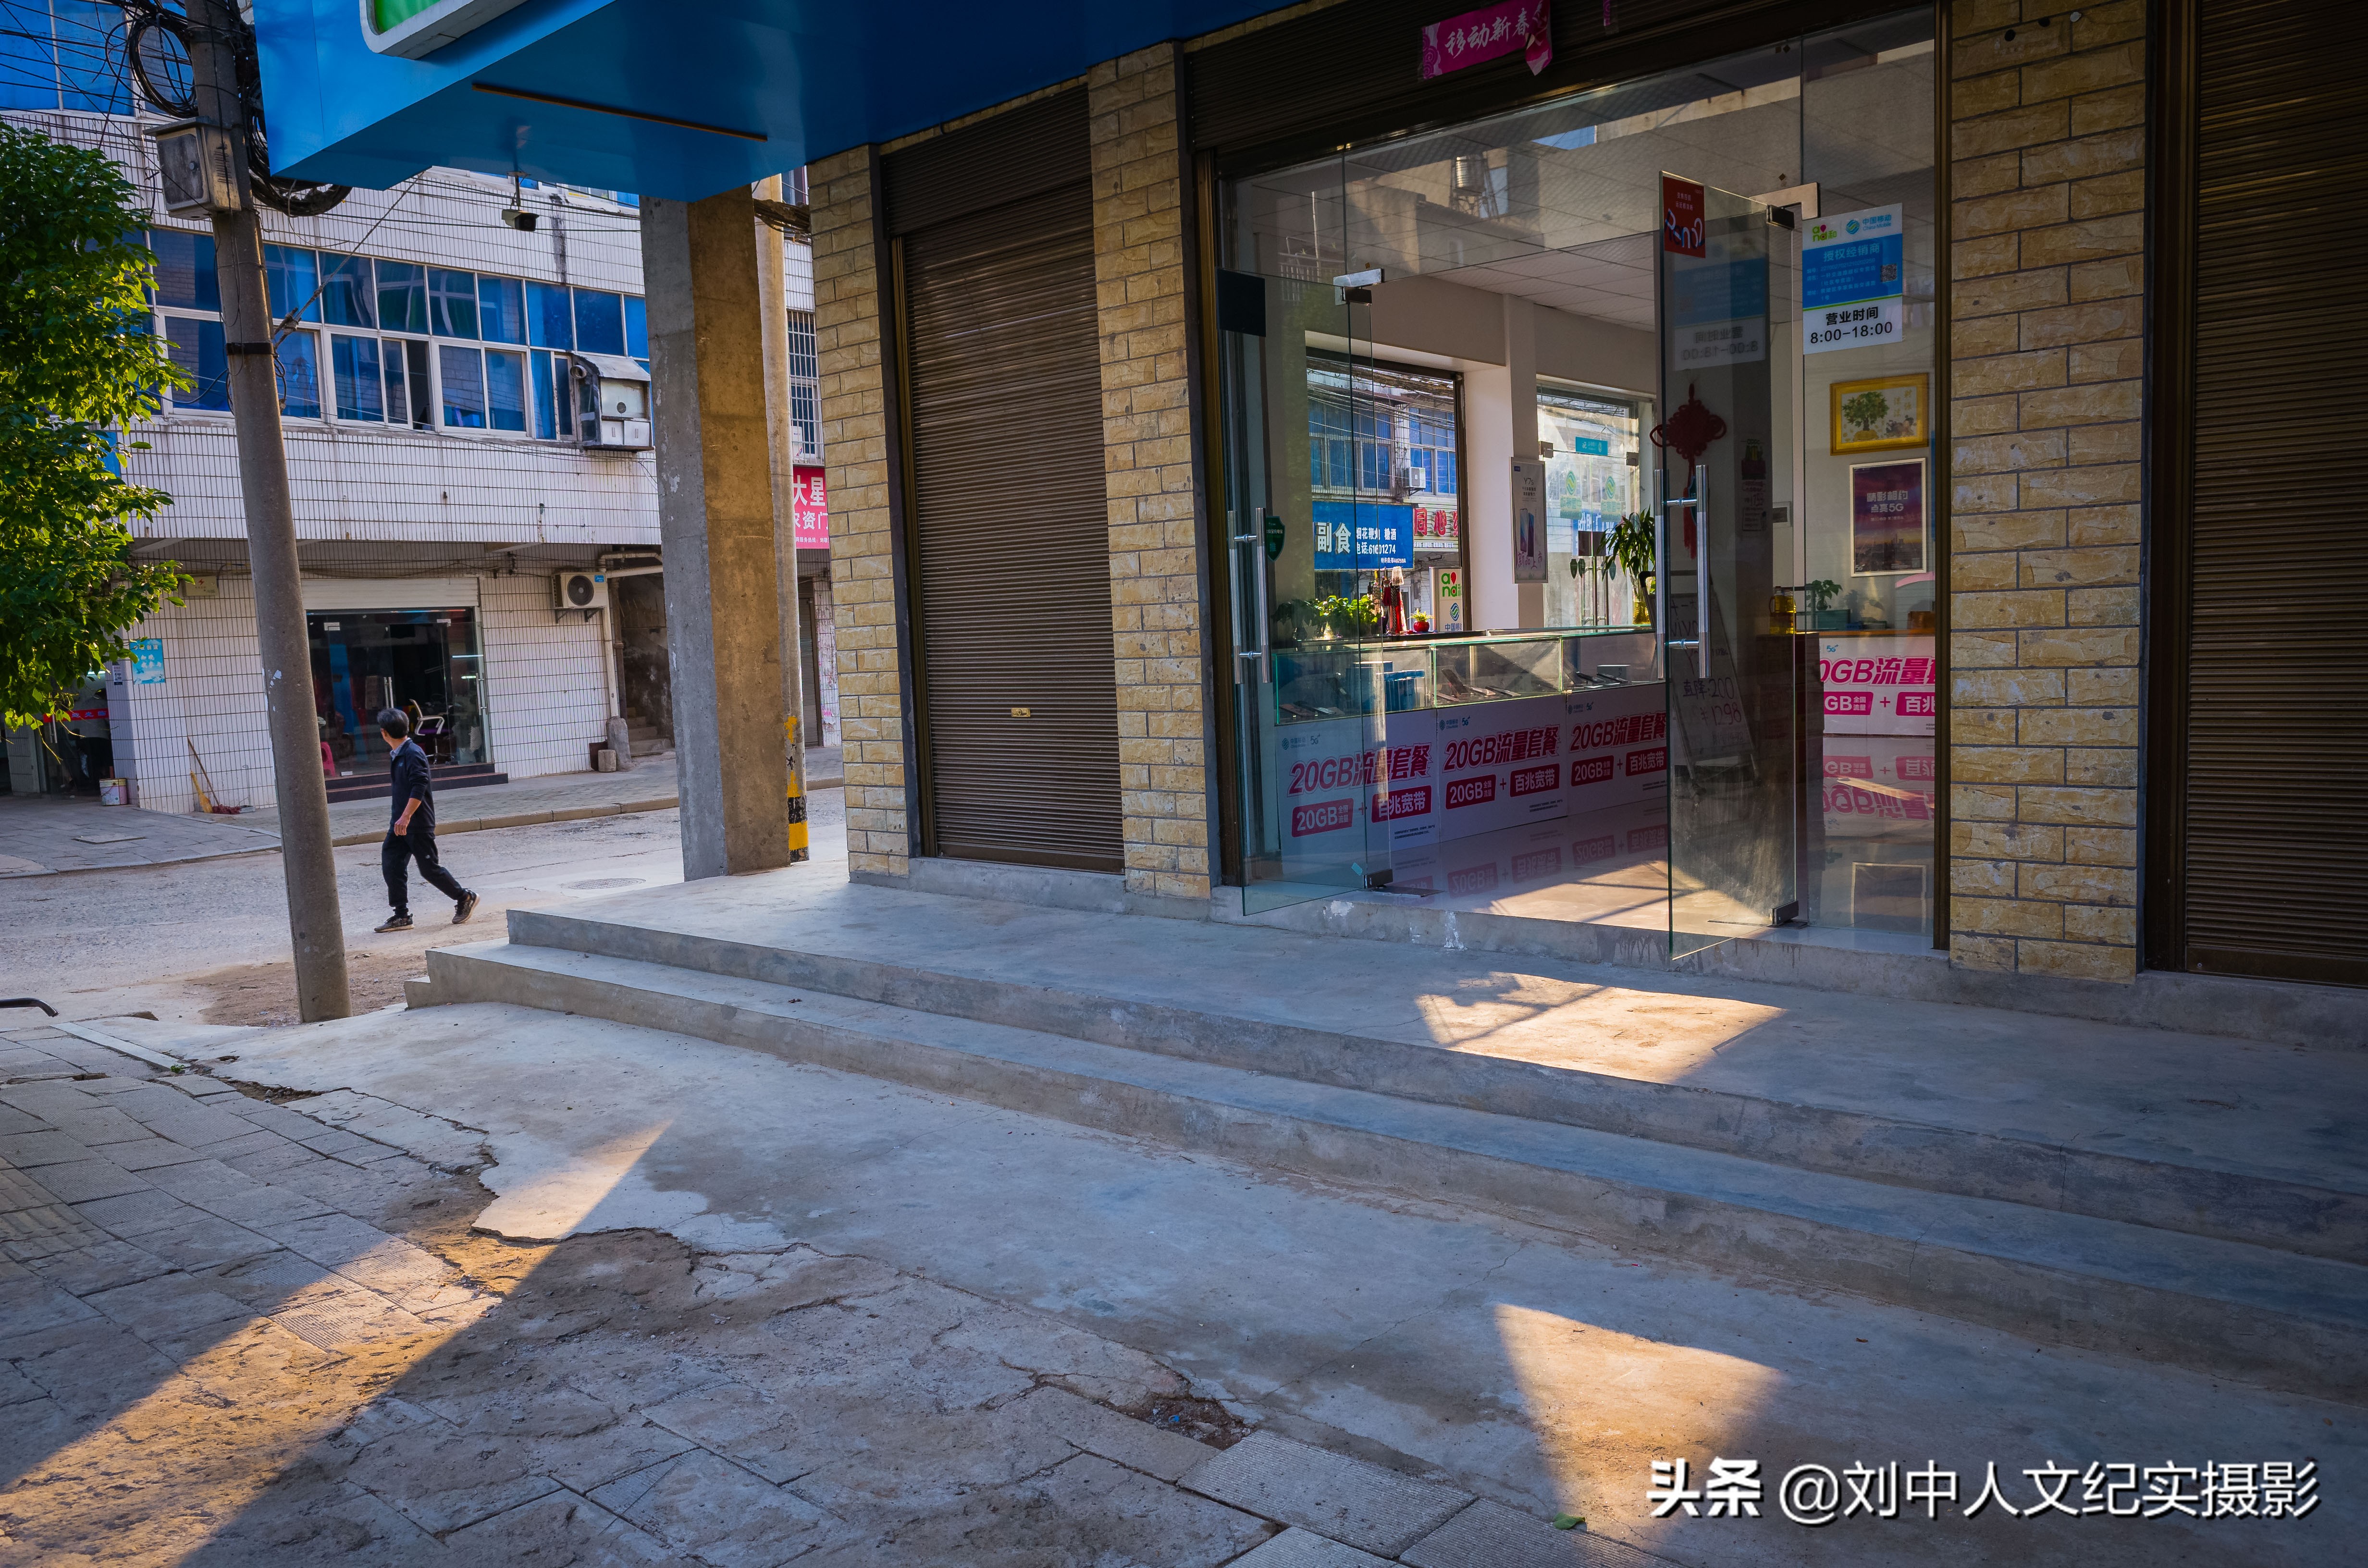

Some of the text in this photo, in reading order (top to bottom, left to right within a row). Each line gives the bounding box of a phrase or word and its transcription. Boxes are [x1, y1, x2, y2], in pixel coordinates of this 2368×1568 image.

[1444, 8, 1530, 59] 移动新春
[1862, 214, 1891, 225] 中国移动
[1823, 242, 1880, 262] 授权经销商
[1825, 306, 1878, 326] 营业时间
[1810, 321, 1893, 344] 8:00-18:00
[793, 475, 826, 506] 大星
[1871, 503, 1904, 513] 点亮5G
[1317, 522, 1351, 554] 副食
[1384, 527, 1396, 540] 糖酒
[1825, 695, 1852, 711] GB
[1310, 735, 1319, 745] 5G
[1569, 712, 1667, 752] 20GB流量套餐
[1443, 725, 1561, 772] 20GB流量套餐
[1288, 744, 1432, 796] 20GB流量套餐
[1574, 761, 1603, 782] 20GB
[1629, 750, 1665, 772] 百兆宽带
[1483, 780, 1492, 788] 全国
[1515, 768, 1555, 792] 百兆宽带
[1450, 782, 1483, 804] 20GB
[1483, 789, 1492, 797] 流量
[1338, 804, 1348, 814] 全国
[1377, 790, 1426, 818] 百兆宽带
[1296, 807, 1338, 832] 20GB
[1338, 814, 1348, 823] 流量
